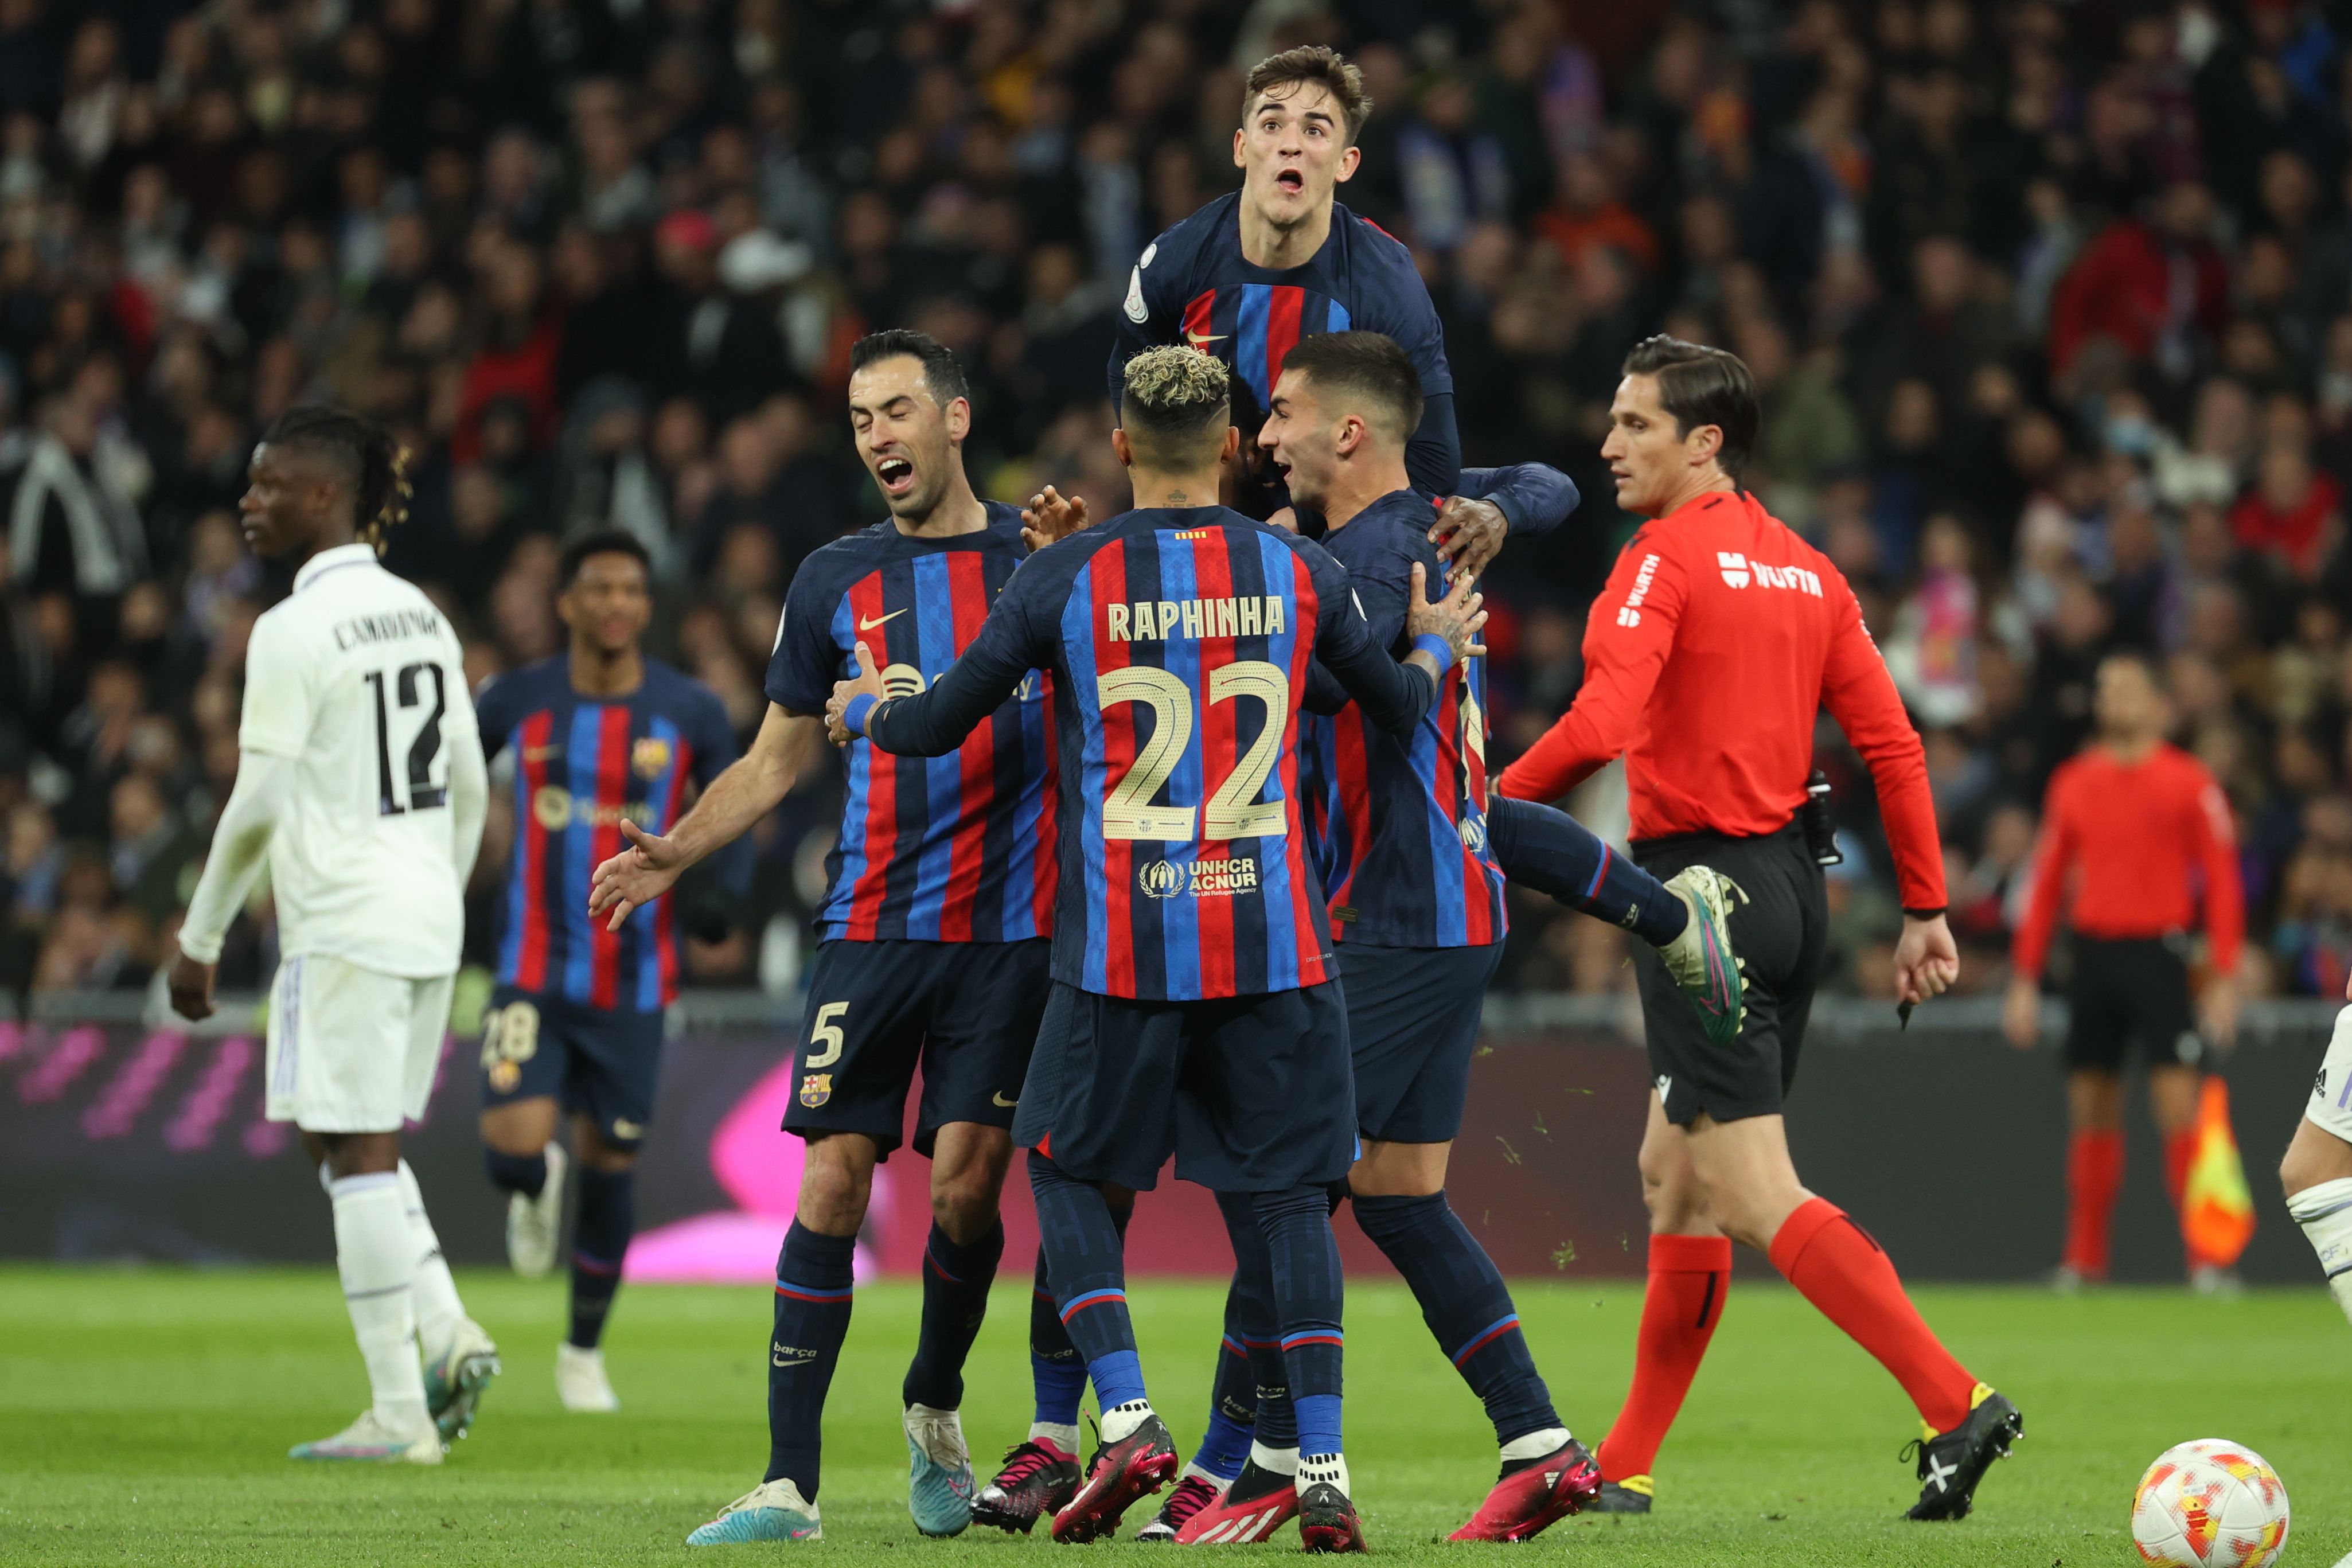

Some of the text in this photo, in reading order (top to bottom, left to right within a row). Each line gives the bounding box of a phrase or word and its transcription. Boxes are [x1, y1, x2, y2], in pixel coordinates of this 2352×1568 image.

[1108, 596, 1285, 642] RAPHINHA
[364, 661, 448, 815] 12
[1097, 661, 1289, 841] 22
[1188, 872, 1257, 890] ACNUR
[1189, 858, 1255, 875] UNHCR
[805, 1001, 849, 1068] 5
[774, 1341, 817, 1358] barça
